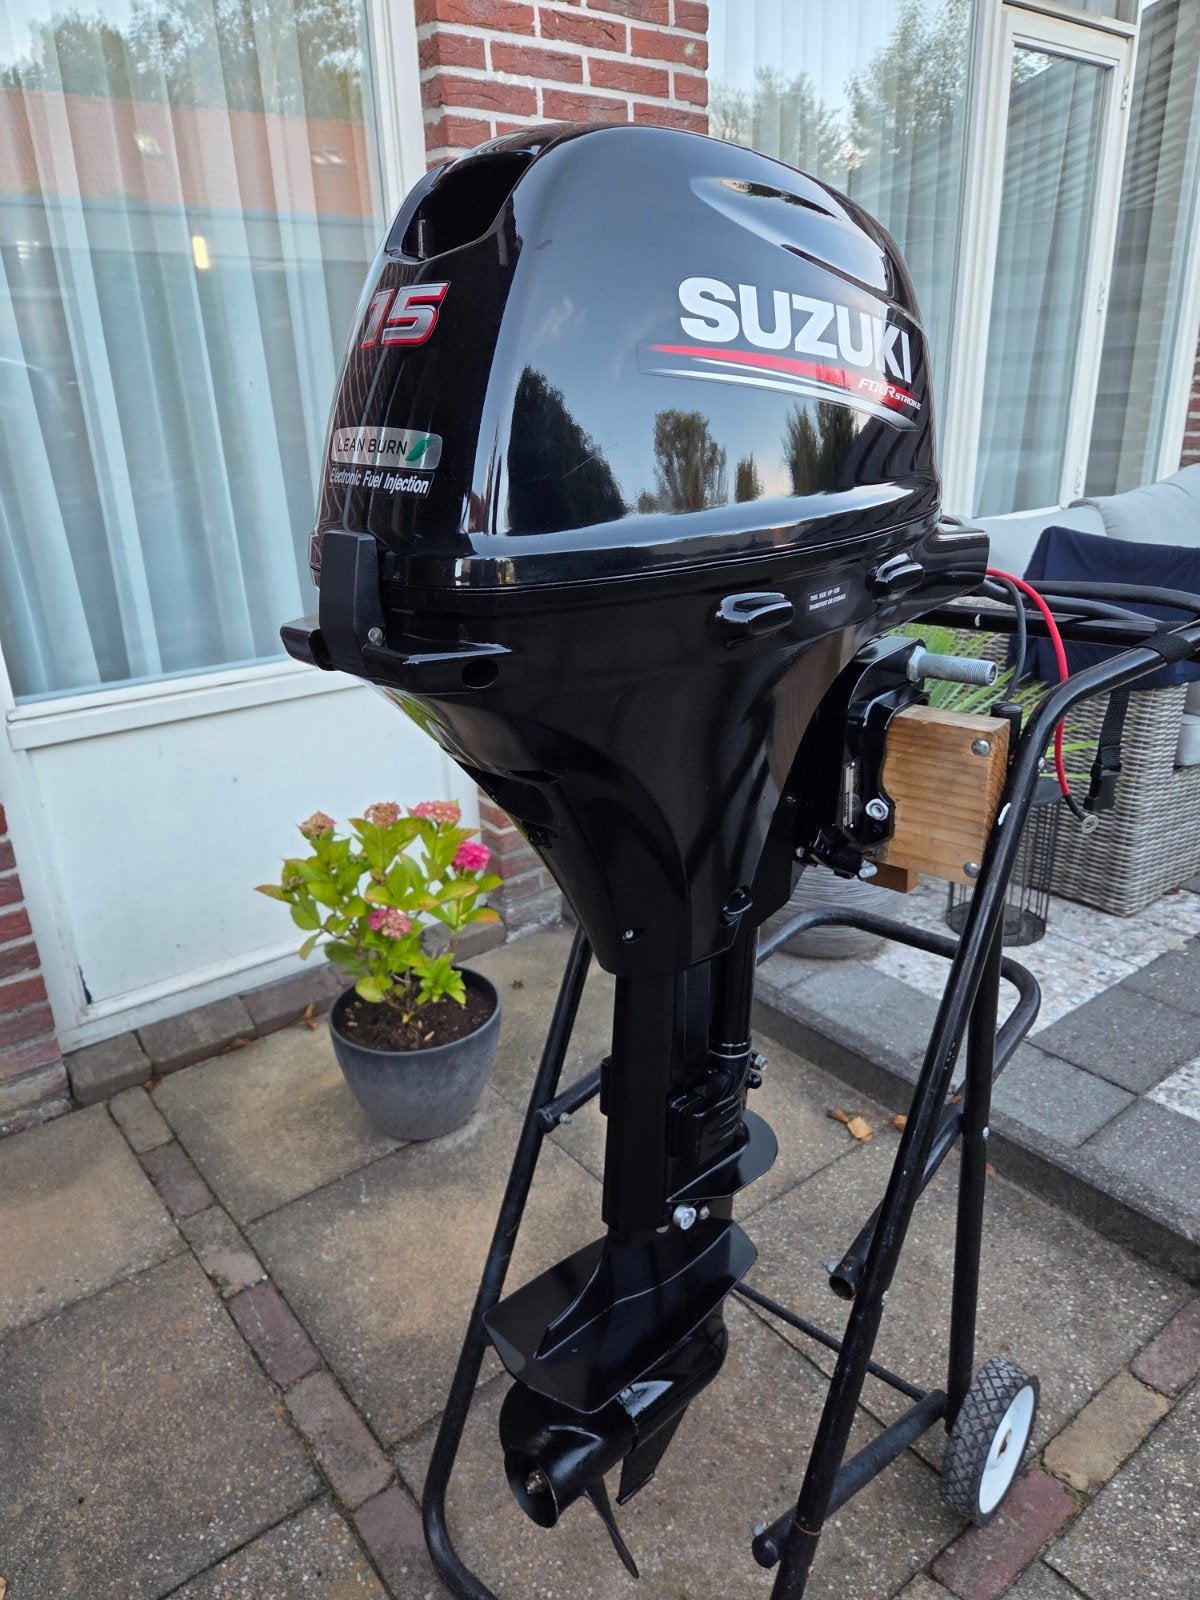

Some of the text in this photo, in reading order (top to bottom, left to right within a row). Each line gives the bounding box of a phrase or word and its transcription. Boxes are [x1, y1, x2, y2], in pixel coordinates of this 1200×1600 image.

[361, 281, 450, 349] 15
[678, 277, 911, 384] SUZUKI
[858, 377, 922, 410] FOUR STROKE
[337, 438, 407, 456] LEAN BURN
[329, 467, 430, 495] Electronic Fuel Injection
